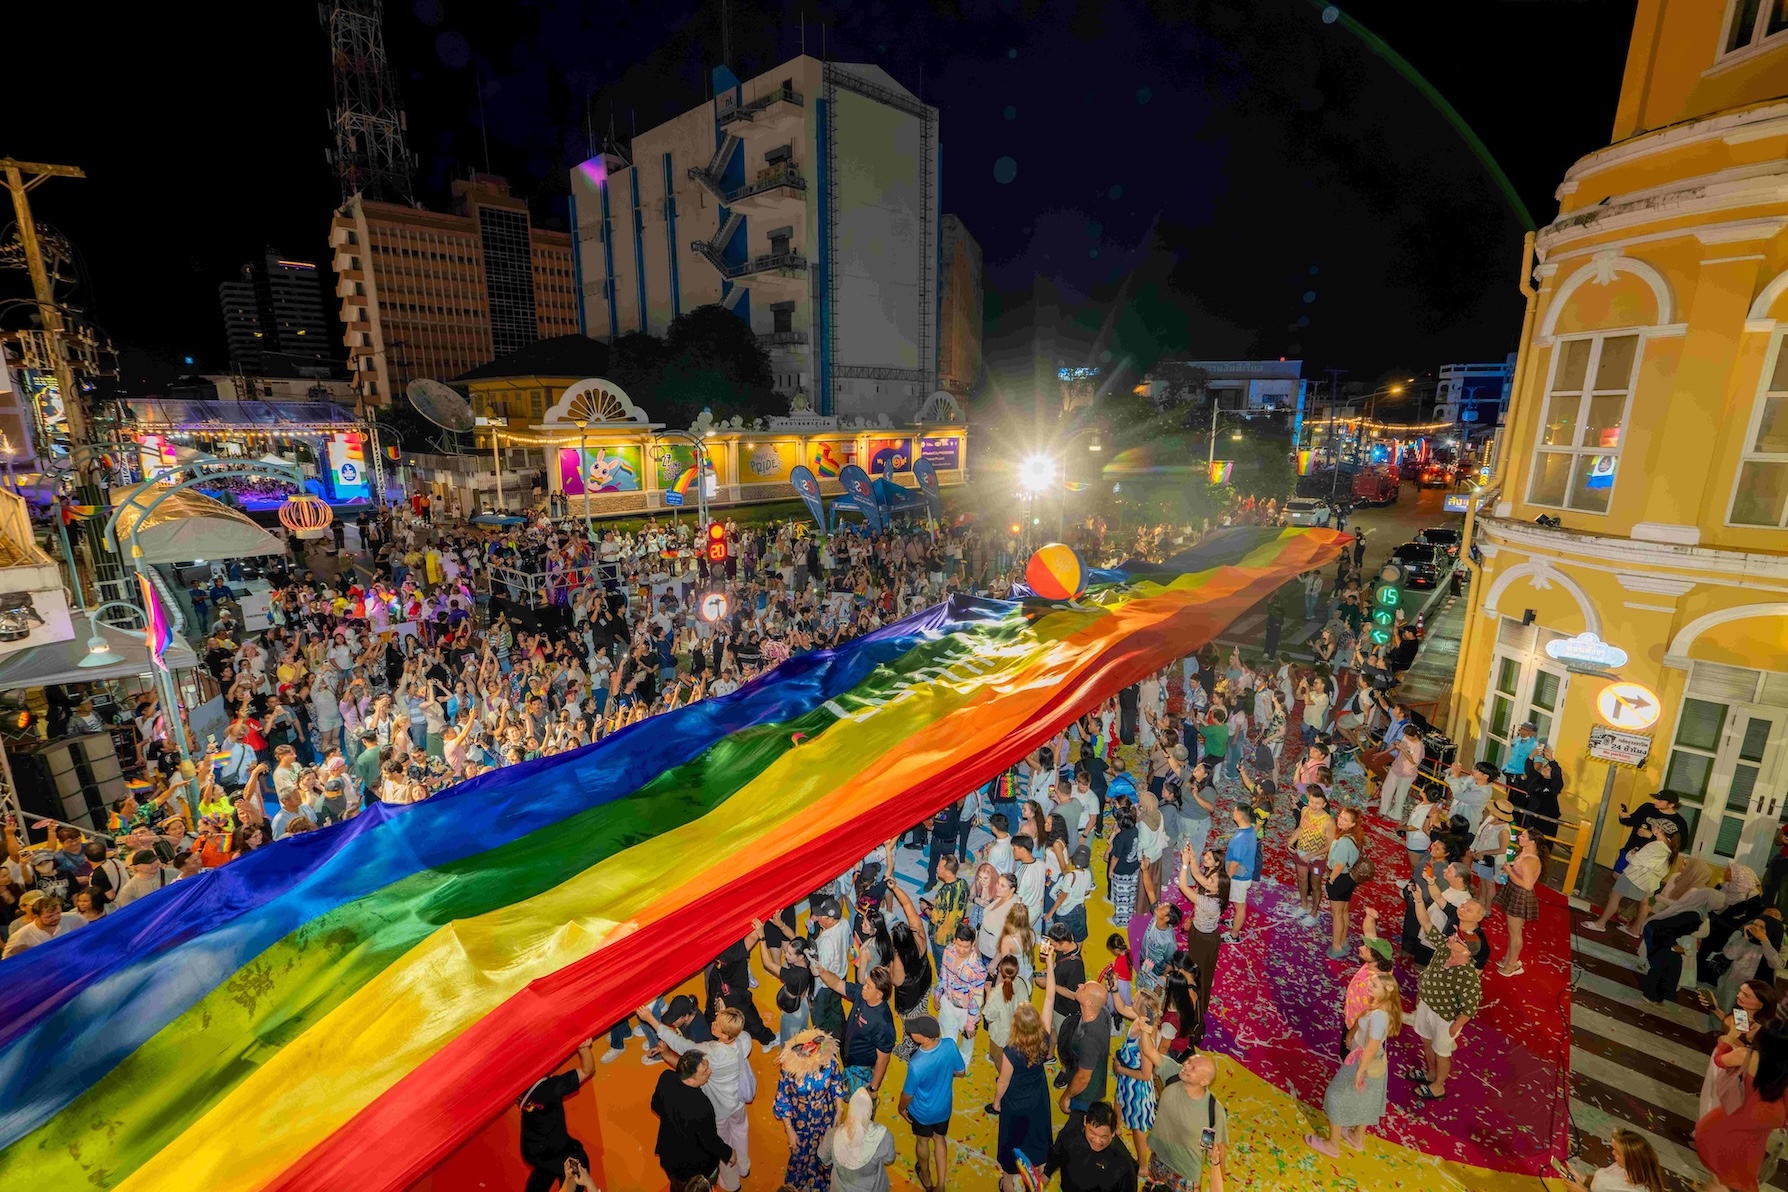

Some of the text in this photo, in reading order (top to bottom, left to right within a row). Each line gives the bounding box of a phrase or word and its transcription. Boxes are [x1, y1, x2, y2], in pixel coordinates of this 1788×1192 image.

[661, 454, 671, 466] 27
[750, 459, 779, 475] PRIDE
[710, 544, 725, 559] 20
[1383, 589, 1397, 604] 15
